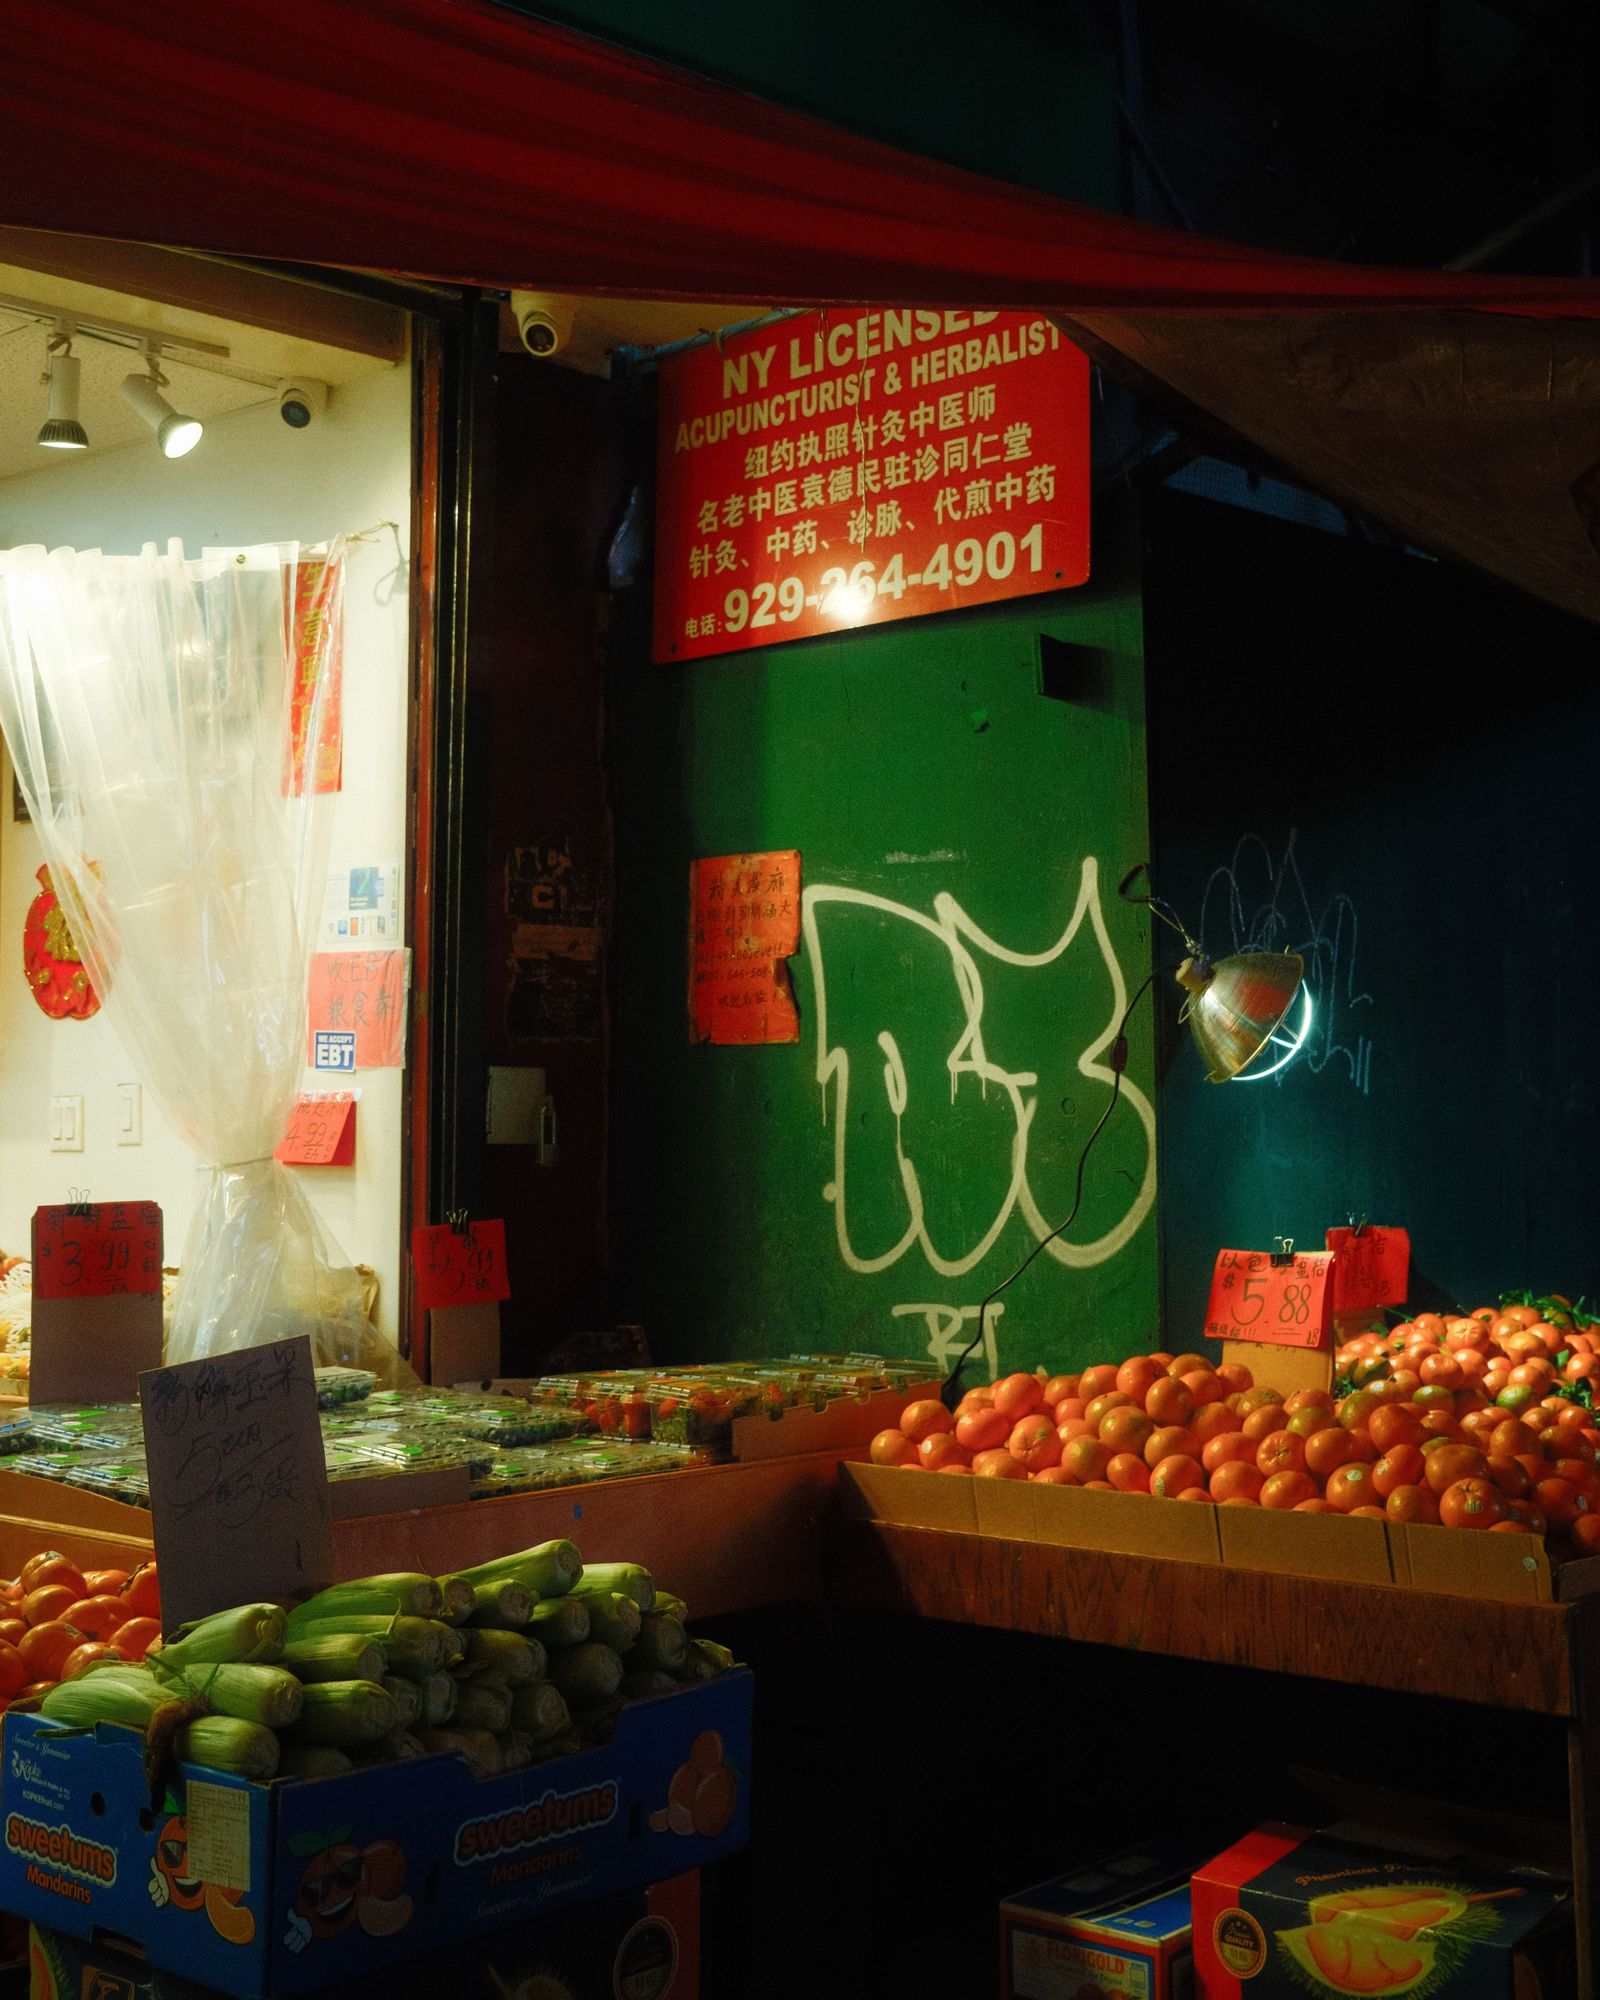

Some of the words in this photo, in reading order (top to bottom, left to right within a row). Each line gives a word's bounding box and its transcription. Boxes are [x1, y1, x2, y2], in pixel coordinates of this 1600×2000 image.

[674, 368, 876, 455] ACUPUNCTURIST
[883, 361, 903, 396] &
[910, 320, 1060, 389] HERBALIST
[721, 345, 777, 400] NY
[743, 383, 997, 480] 纽约执照针灸中医师
[696, 421, 1033, 536] 名老中医袁德民驻诊同仁堂
[932, 463, 1057, 527] 代煎中药
[723, 523, 1044, 634] 929-264-4901
[316, 1043, 354, 1067] EBT
[329, 1034, 353, 1044] ACCEPT
[7, 1815, 115, 1882] sweetums
[456, 1784, 617, 1863] sweetums
[26, 1863, 92, 1905] Mandarins
[489, 1845, 582, 1888] Mandarins
[1045, 1939, 1126, 1975] FLORIGOLD
[1224, 1933, 1255, 1949] QUALITY
